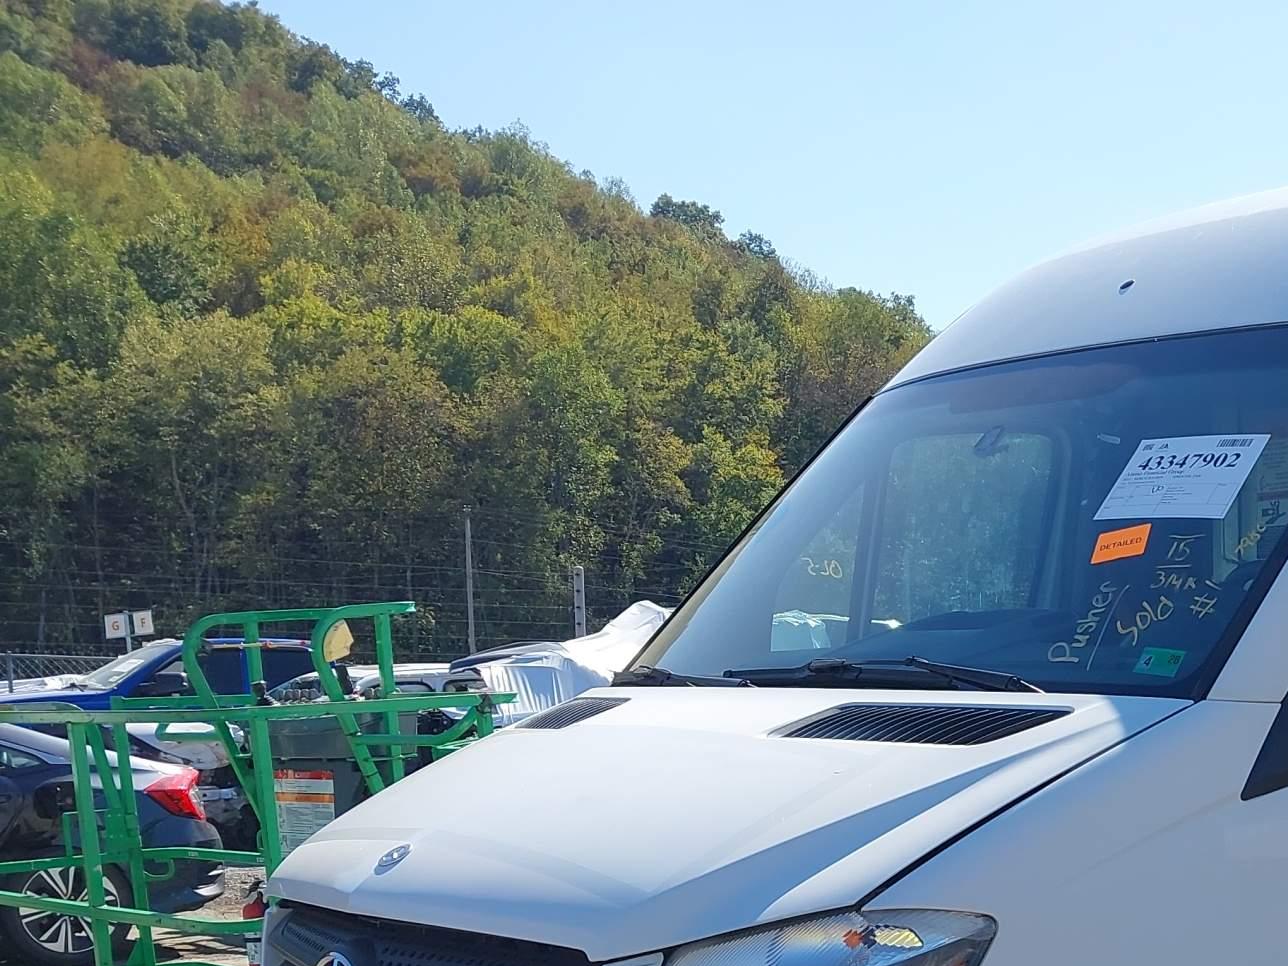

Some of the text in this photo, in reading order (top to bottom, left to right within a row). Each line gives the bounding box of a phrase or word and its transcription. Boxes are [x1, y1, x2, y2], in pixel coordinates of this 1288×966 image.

[1138, 452, 1242, 471] 43347902
[1099, 536, 1143, 551] DETAILED
[111, 620, 120, 631] G
[1048, 581, 1118, 663] Pusher
[1116, 595, 1175, 647] Sold
